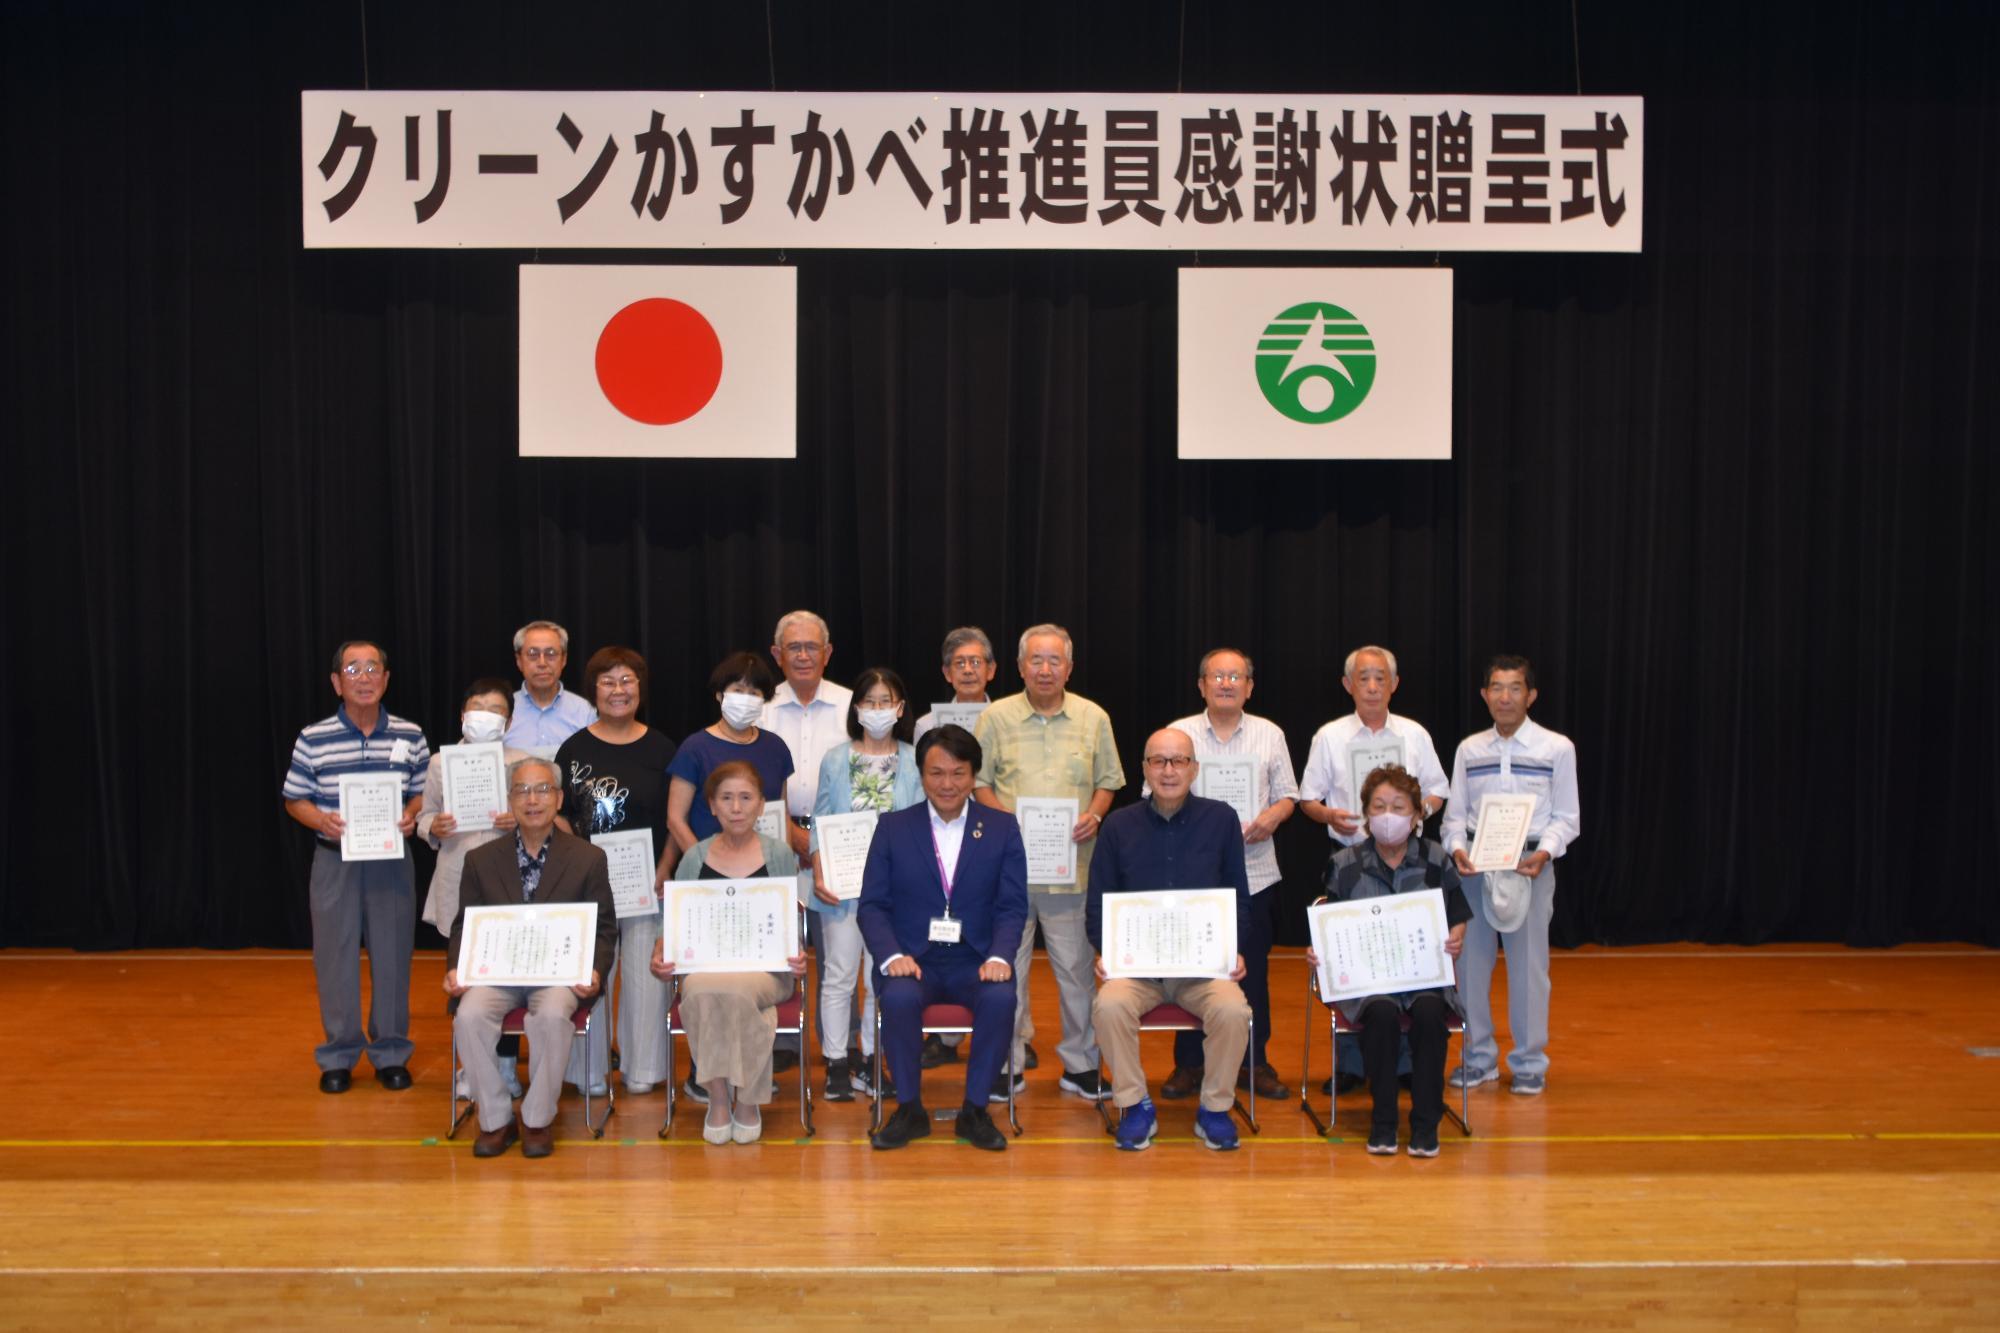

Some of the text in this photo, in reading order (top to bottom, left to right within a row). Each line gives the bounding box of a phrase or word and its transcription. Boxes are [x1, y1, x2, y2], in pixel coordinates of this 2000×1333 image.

[317, 107, 1628, 227] クリーンかすかべ推進員感謝状贈呈式
